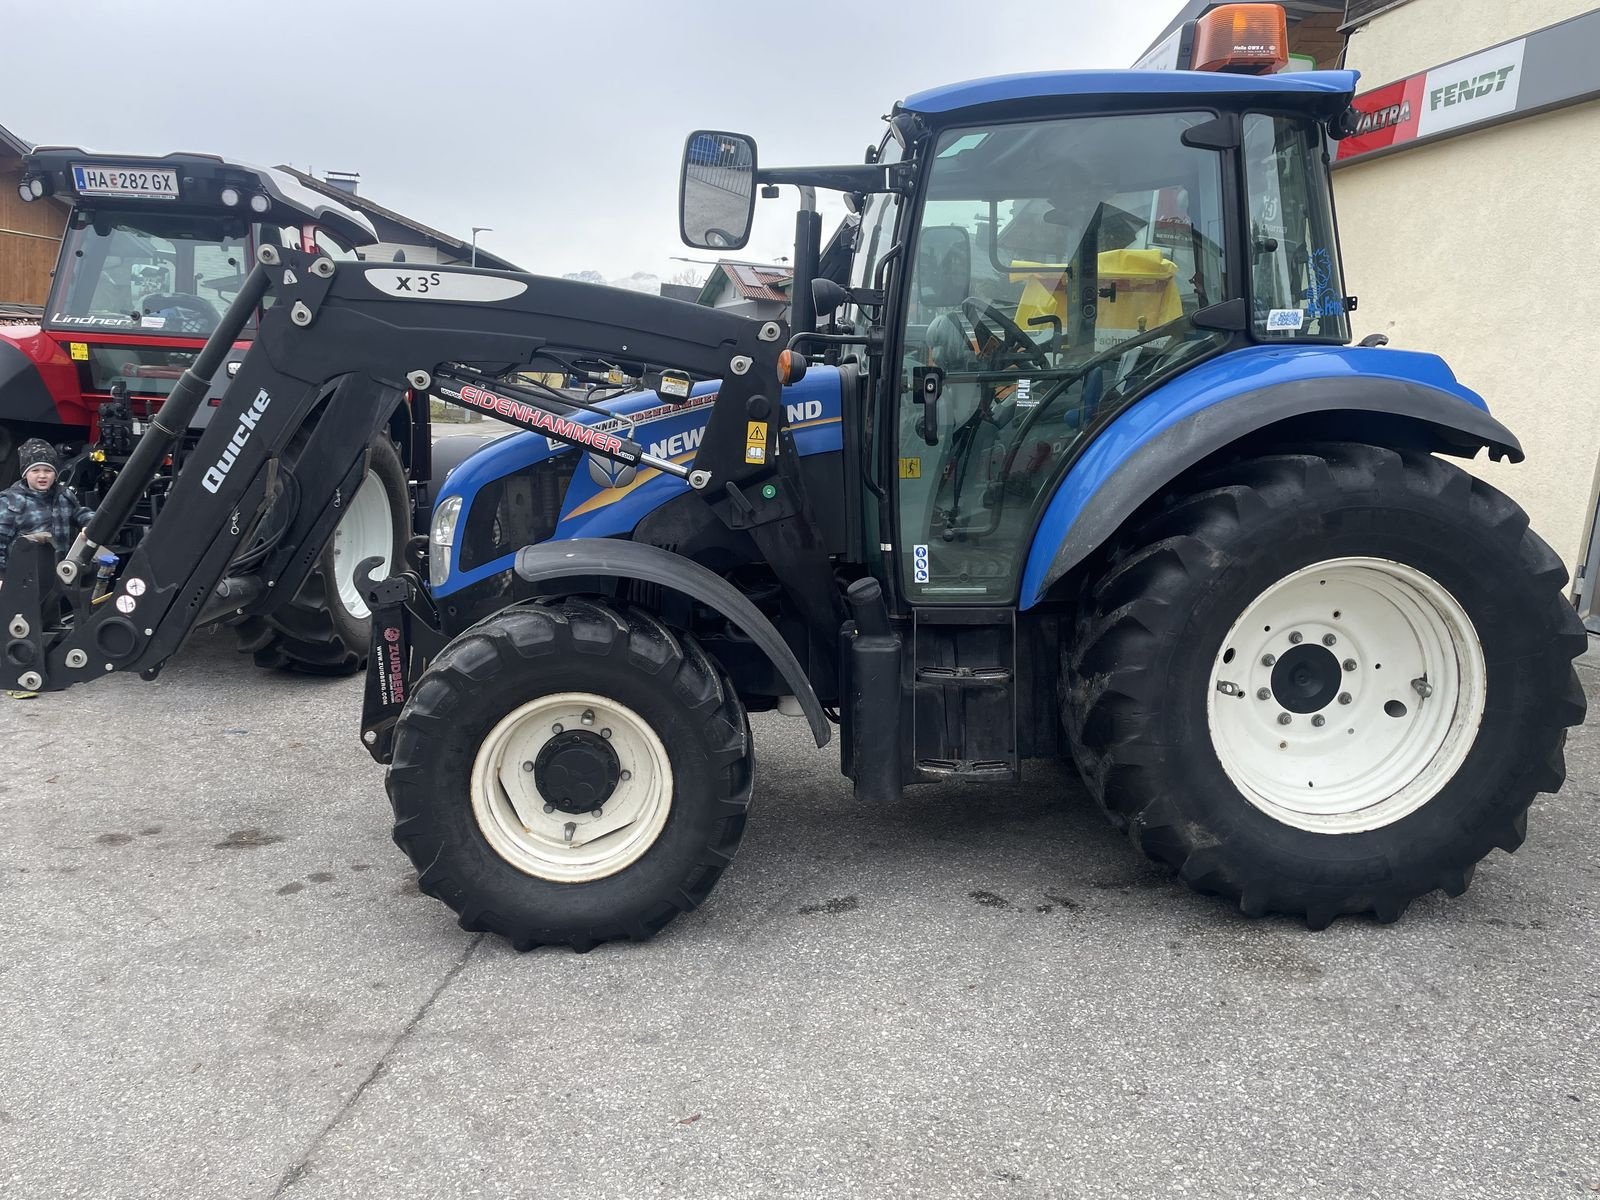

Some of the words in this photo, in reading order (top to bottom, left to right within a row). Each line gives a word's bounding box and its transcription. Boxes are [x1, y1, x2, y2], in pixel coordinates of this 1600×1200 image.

[1430, 65, 1515, 111] FENDT
[87, 171, 109, 188] HA
[119, 173, 149, 190] 282
[152, 174, 172, 191] GX
[51, 312, 131, 326] Lindner
[201, 389, 271, 494] Quicke
[650, 426, 706, 460] NEW
[388, 643, 404, 704] ZUIDBERG
